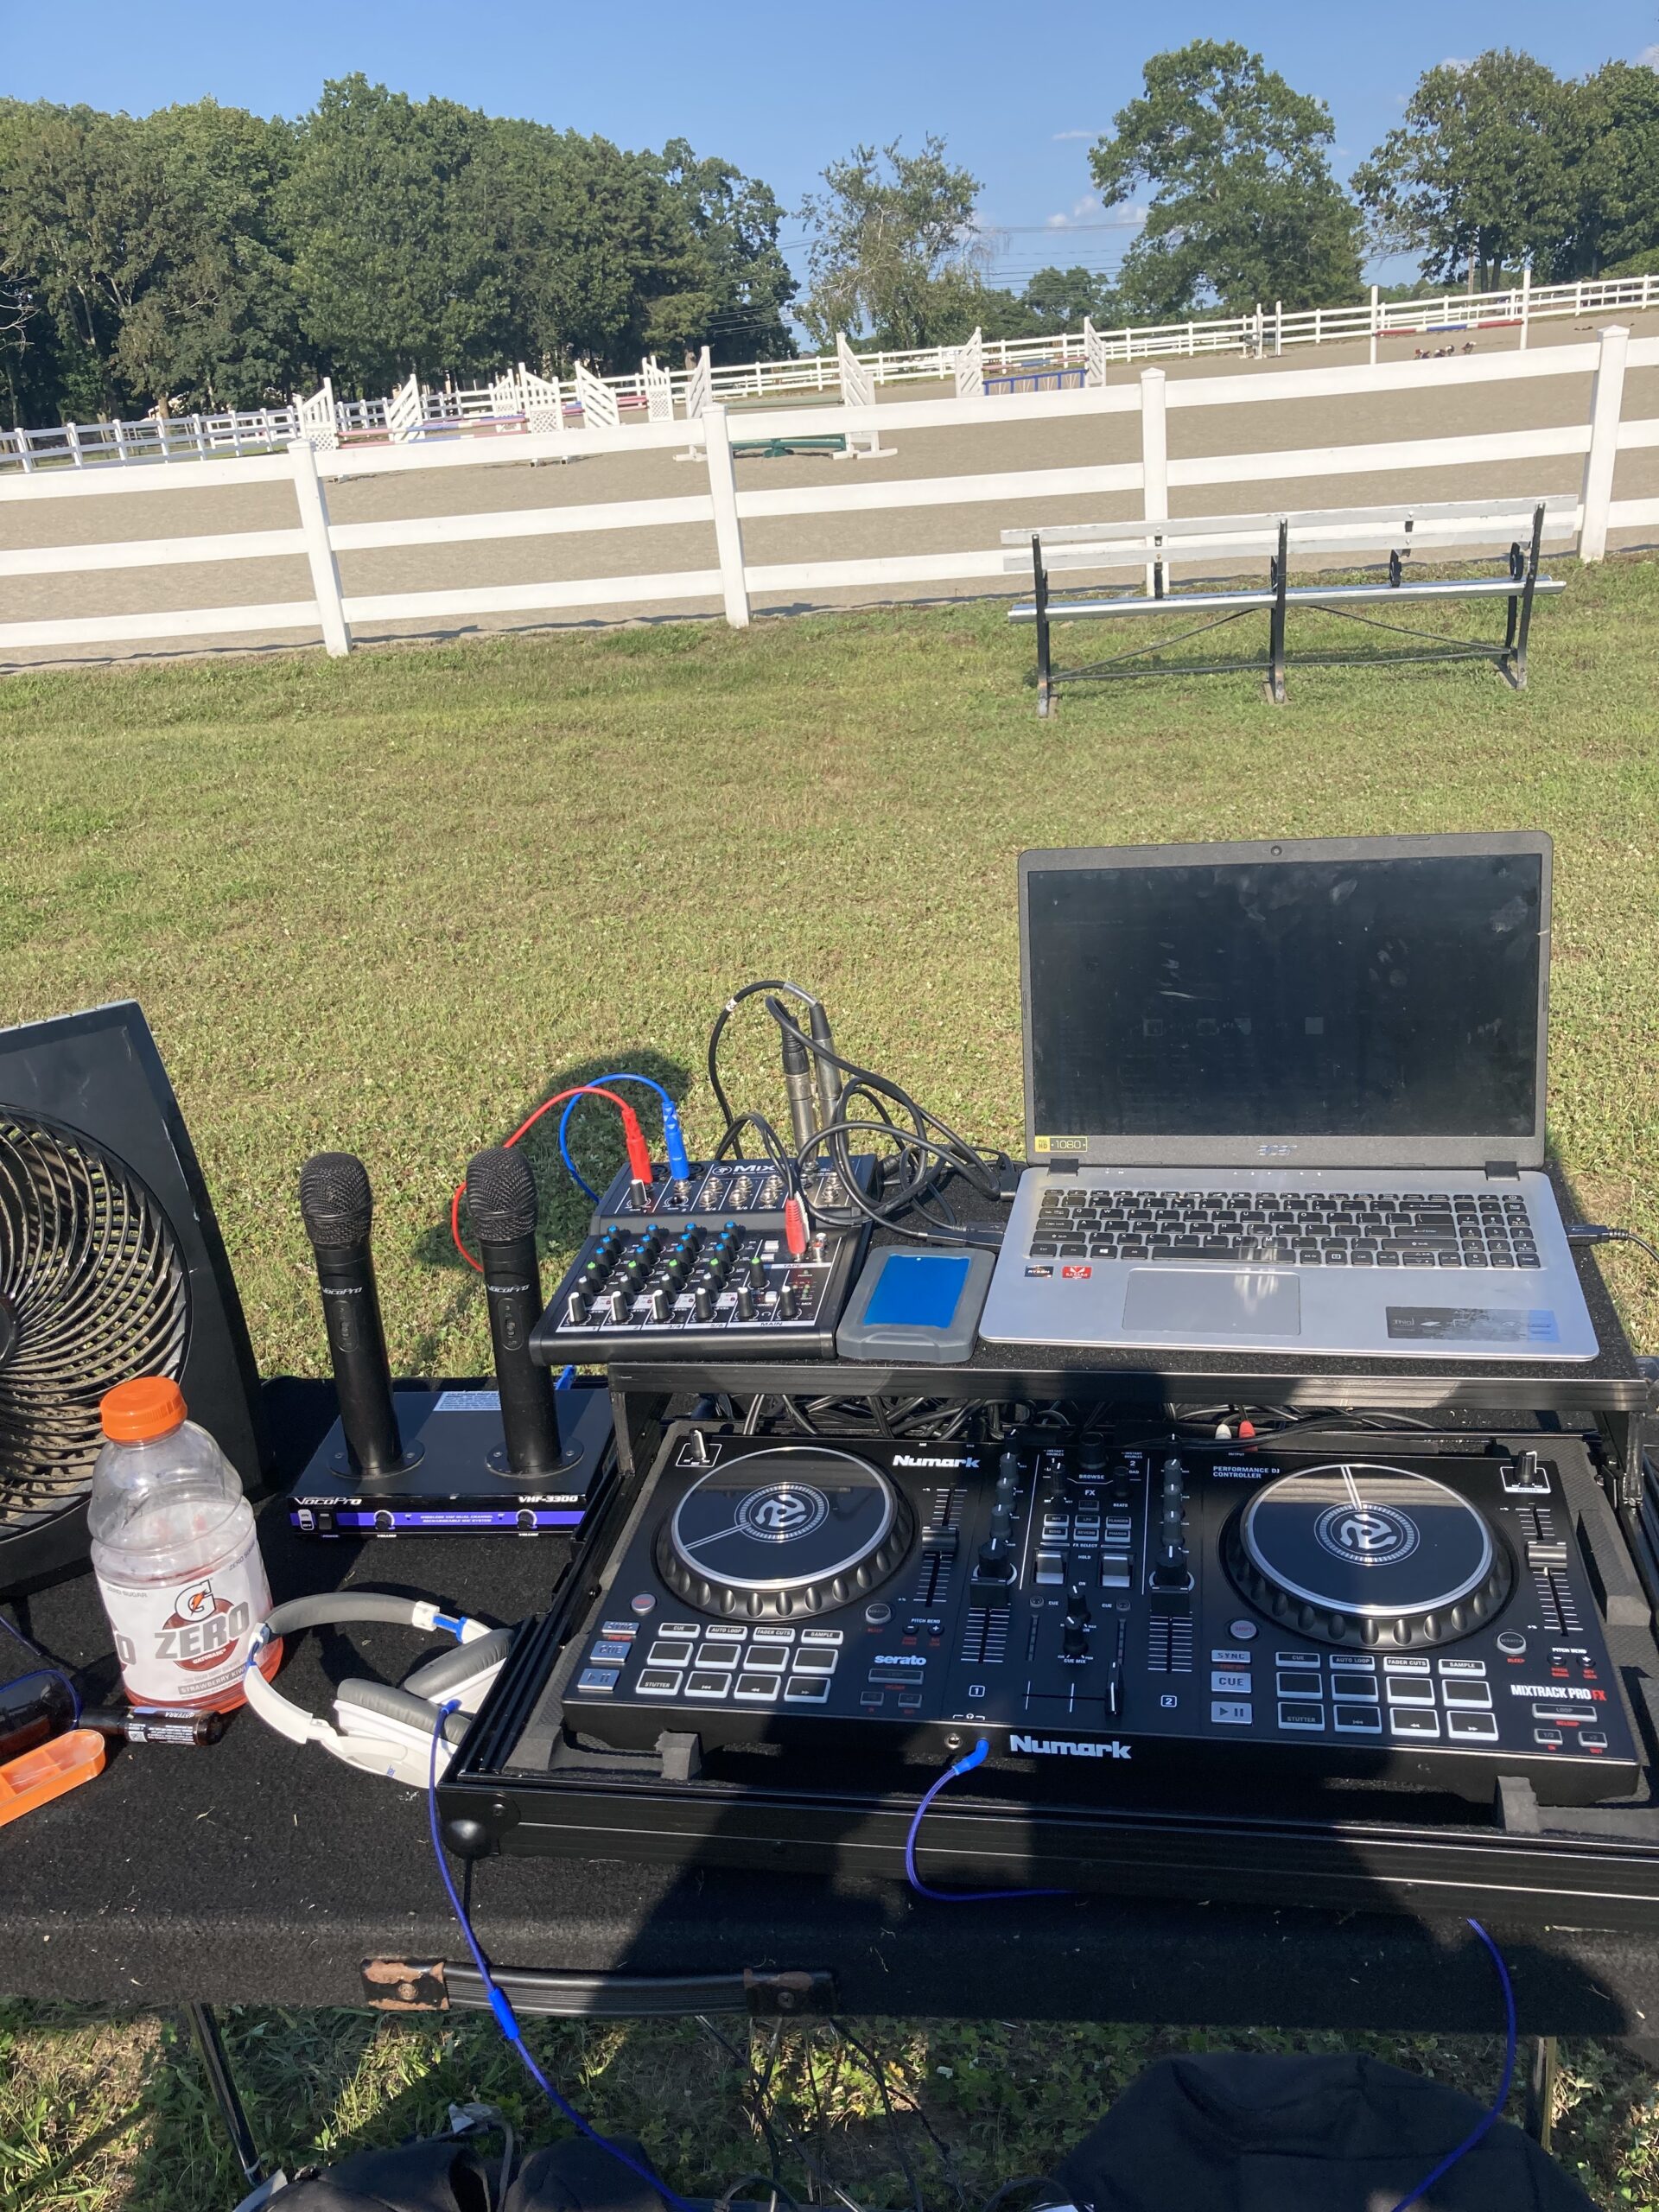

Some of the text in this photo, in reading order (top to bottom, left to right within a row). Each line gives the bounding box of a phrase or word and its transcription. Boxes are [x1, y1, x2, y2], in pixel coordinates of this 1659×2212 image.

[1055, 1141, 1081, 1149] 1080
[321, 1287, 363, 1295] VocoPro
[893, 1455, 981, 1468] Numark
[294, 1497, 363, 1505] VocoPro
[518, 1495, 578, 1503] VHF-3300
[155, 1601, 250, 1660] ZERO
[600, 1645, 624, 1654] CUE
[192, 1649, 224, 1664] GATORADE
[874, 1655, 927, 1666] serato
[181, 1675, 230, 1693] STRAWBERRY
[1218, 1676, 1245, 1687] CUE
[1510, 1685, 1607, 1701] MIXTRACK PRO FX
[1010, 1735, 1132, 1759] Numark
